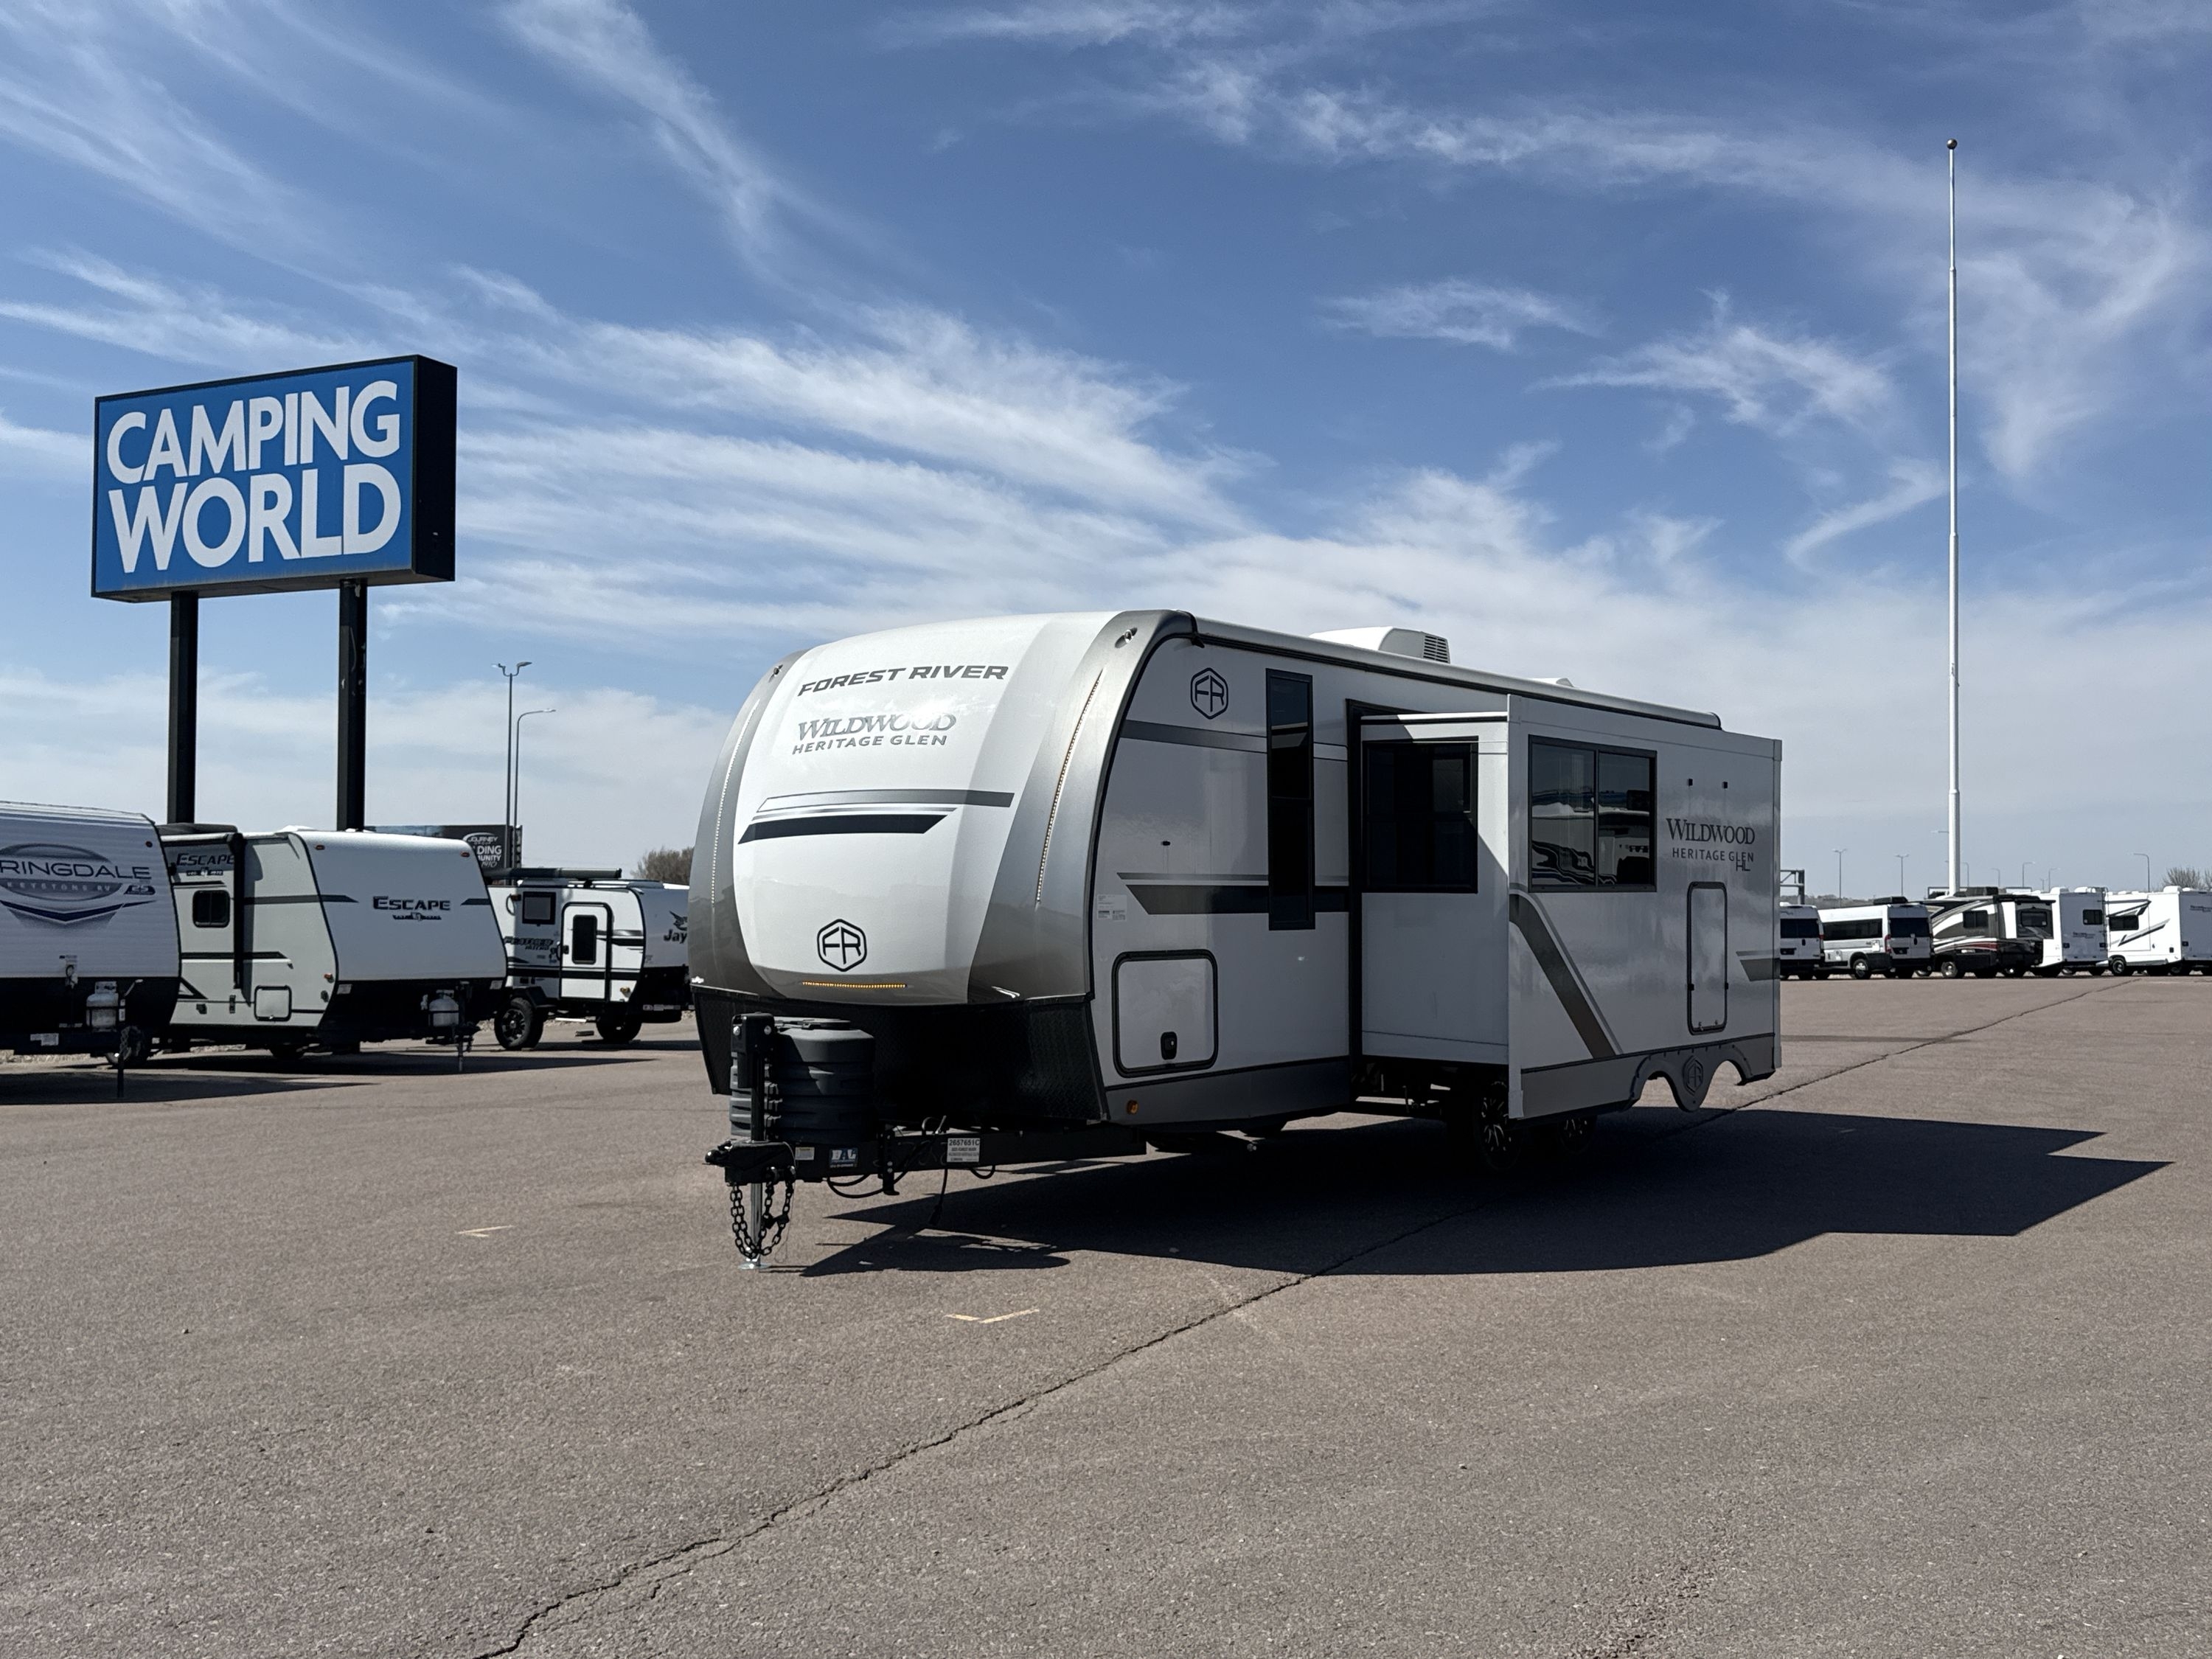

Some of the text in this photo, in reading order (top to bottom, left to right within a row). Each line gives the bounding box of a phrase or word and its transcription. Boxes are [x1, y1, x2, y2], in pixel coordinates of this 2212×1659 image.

[107, 380, 400, 484] CAMPING
[108, 463, 402, 574] WORLD
[798, 665, 1009, 697] FOREST RIVER
[799, 712, 956, 741] WILDWOOD
[792, 735, 947, 754] HERITAGE GLEN
[1666, 818, 1755, 844] WILDWOOD
[176, 852, 234, 866] ESCAPE
[1672, 847, 1754, 862] HERITAGE GLEN
[372, 896, 451, 911] ESCAPE
